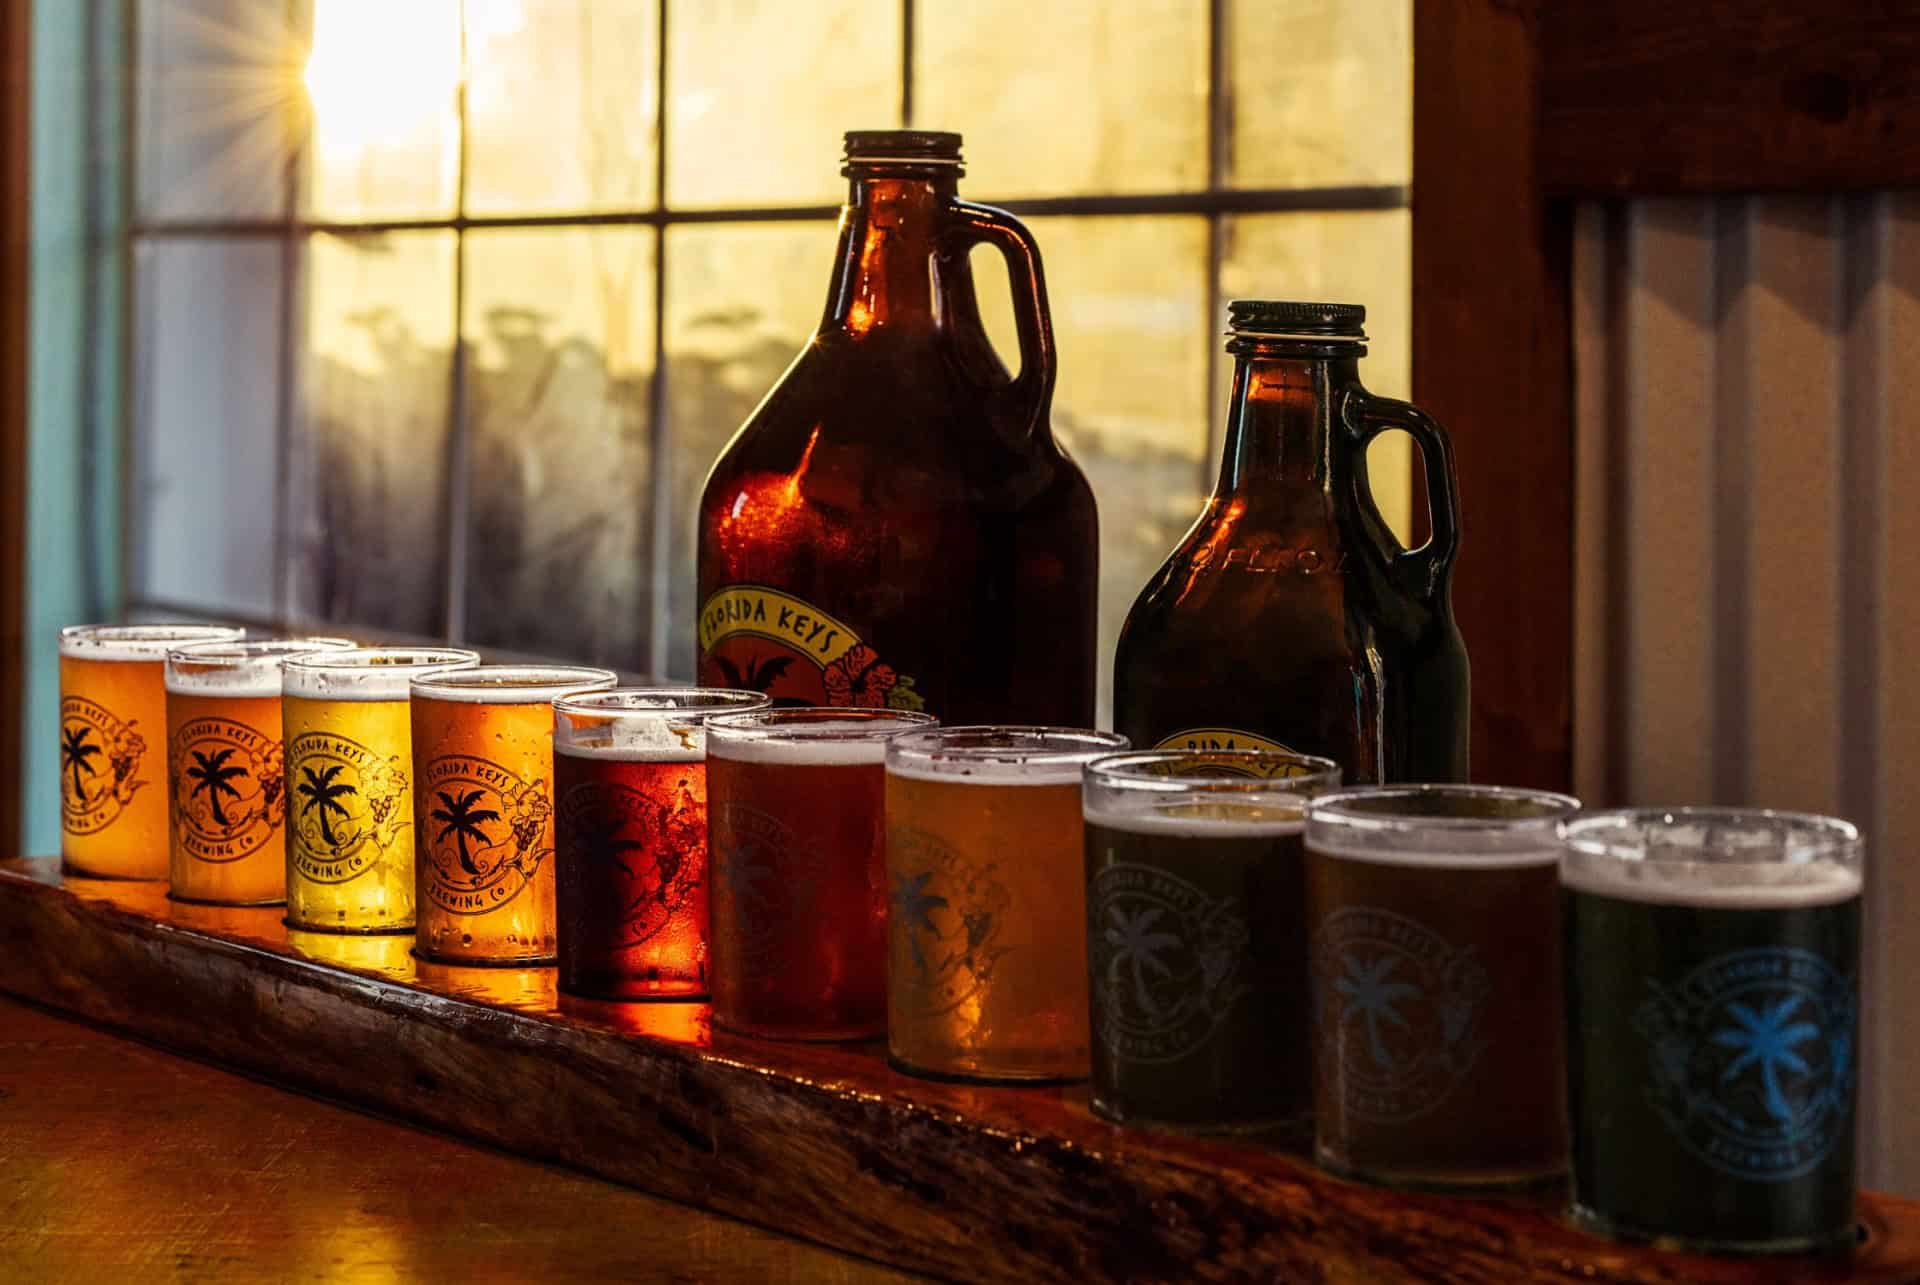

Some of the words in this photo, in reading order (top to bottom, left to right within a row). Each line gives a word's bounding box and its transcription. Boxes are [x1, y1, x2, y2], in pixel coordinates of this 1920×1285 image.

[704, 598, 767, 640] FLORIDA
[777, 605, 839, 653] KEYS
[227, 727, 257, 747] KEYS
[335, 742, 366, 764] KEYS
[427, 763, 469, 784] FLORIDA
[476, 765, 510, 788] KEYS
[430, 883, 484, 908] BREWING
